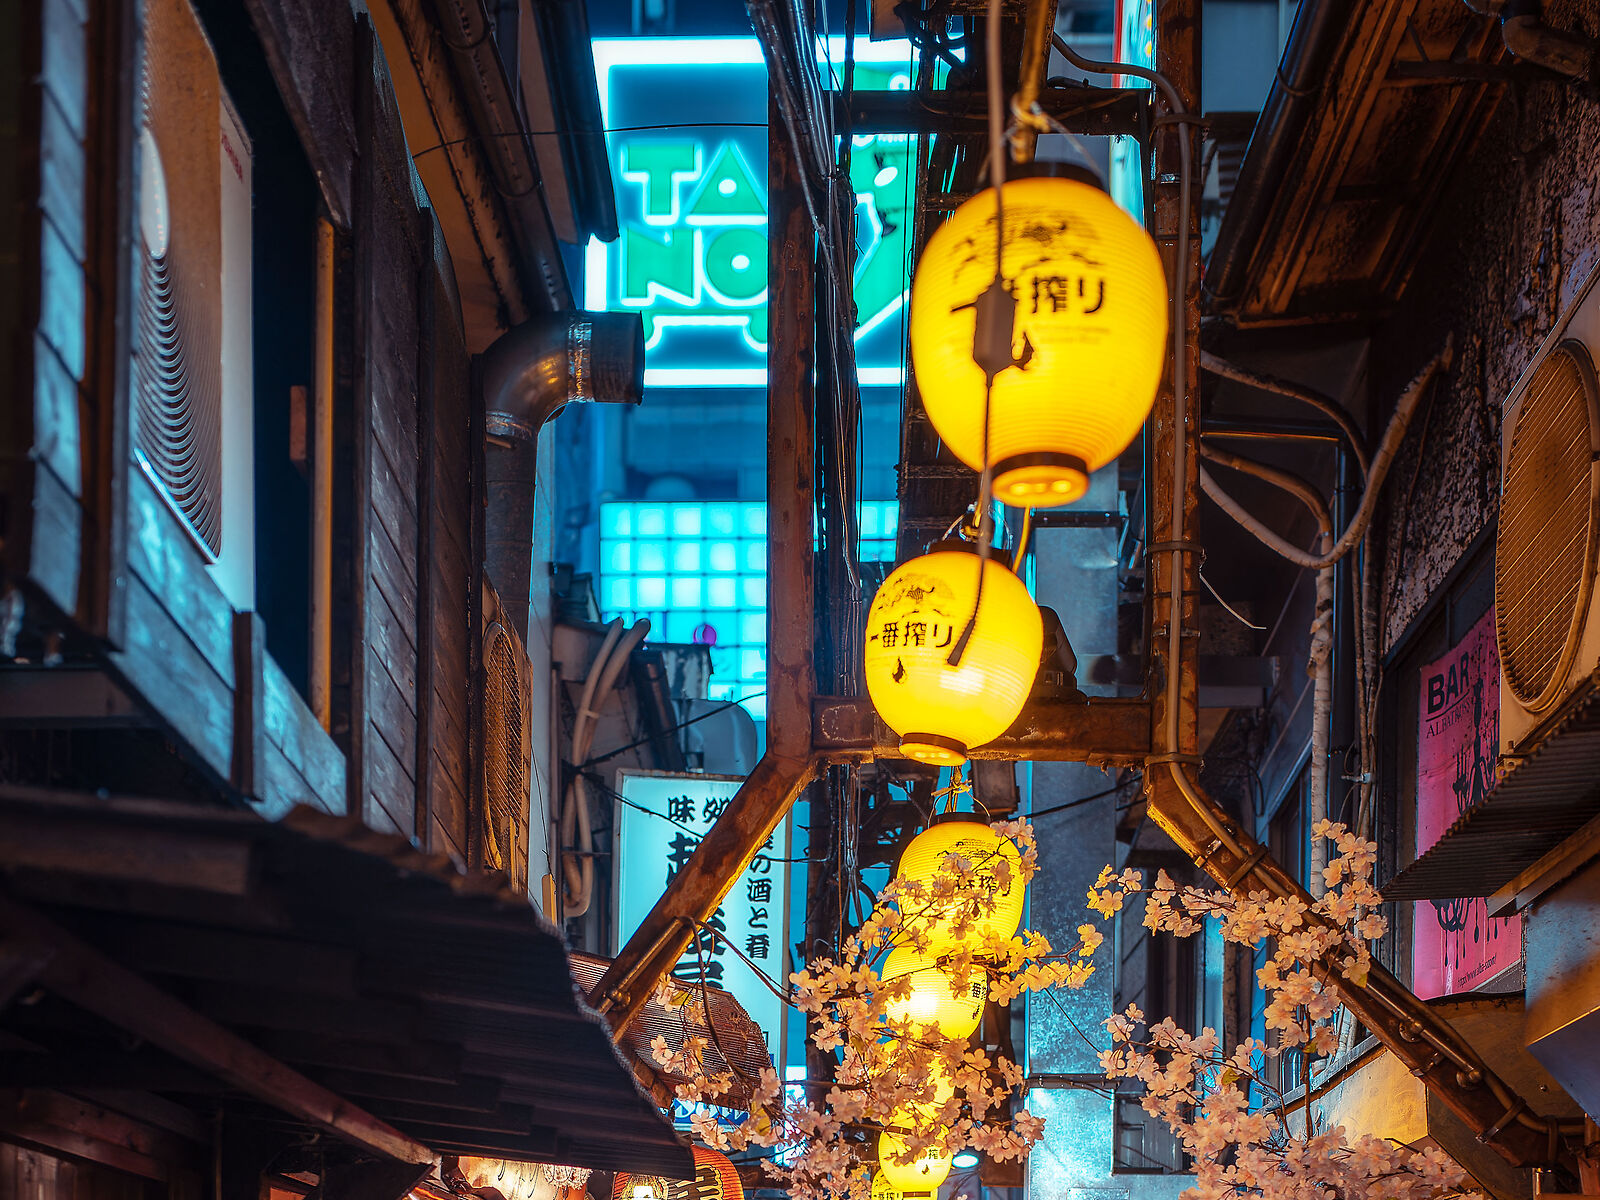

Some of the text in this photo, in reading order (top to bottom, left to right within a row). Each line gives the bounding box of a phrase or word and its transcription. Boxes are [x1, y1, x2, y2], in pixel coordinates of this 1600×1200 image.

[950, 275, 1106, 315] 一搾り
[870, 621, 953, 649] 一番搾り
[1427, 651, 1470, 715] BAR
